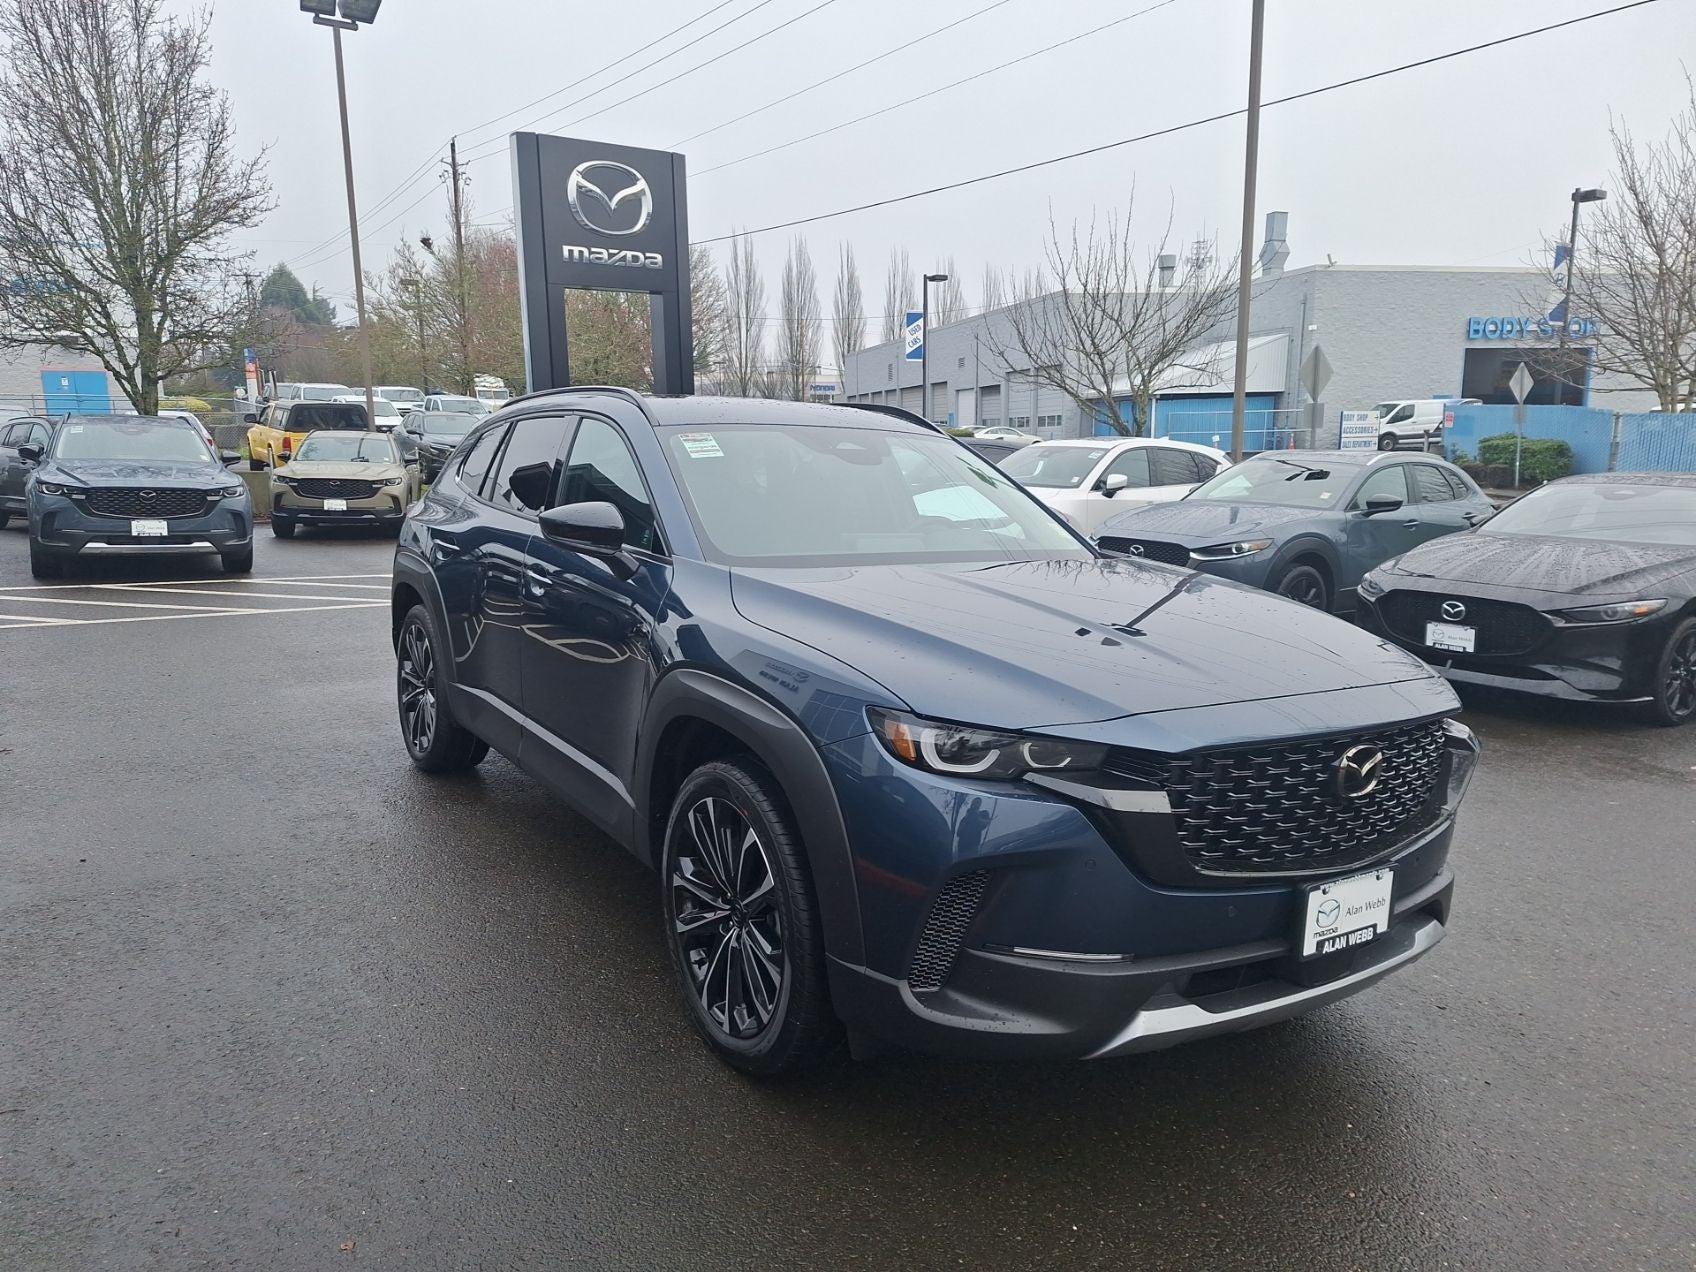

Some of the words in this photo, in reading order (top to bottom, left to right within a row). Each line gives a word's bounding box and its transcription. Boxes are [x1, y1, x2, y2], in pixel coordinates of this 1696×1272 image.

[908, 323, 922, 336] USED
[1467, 317, 1530, 340] BODY
[908, 336, 921, 348] CARS
[1356, 413, 1368, 421] SHOP
[1343, 426, 1374, 434] ACCESSORIES
[1345, 905, 1363, 917] Alan
[1365, 897, 1386, 911] Webb
[1322, 935, 1347, 954] ALAN
[1348, 927, 1374, 946] WEBB
